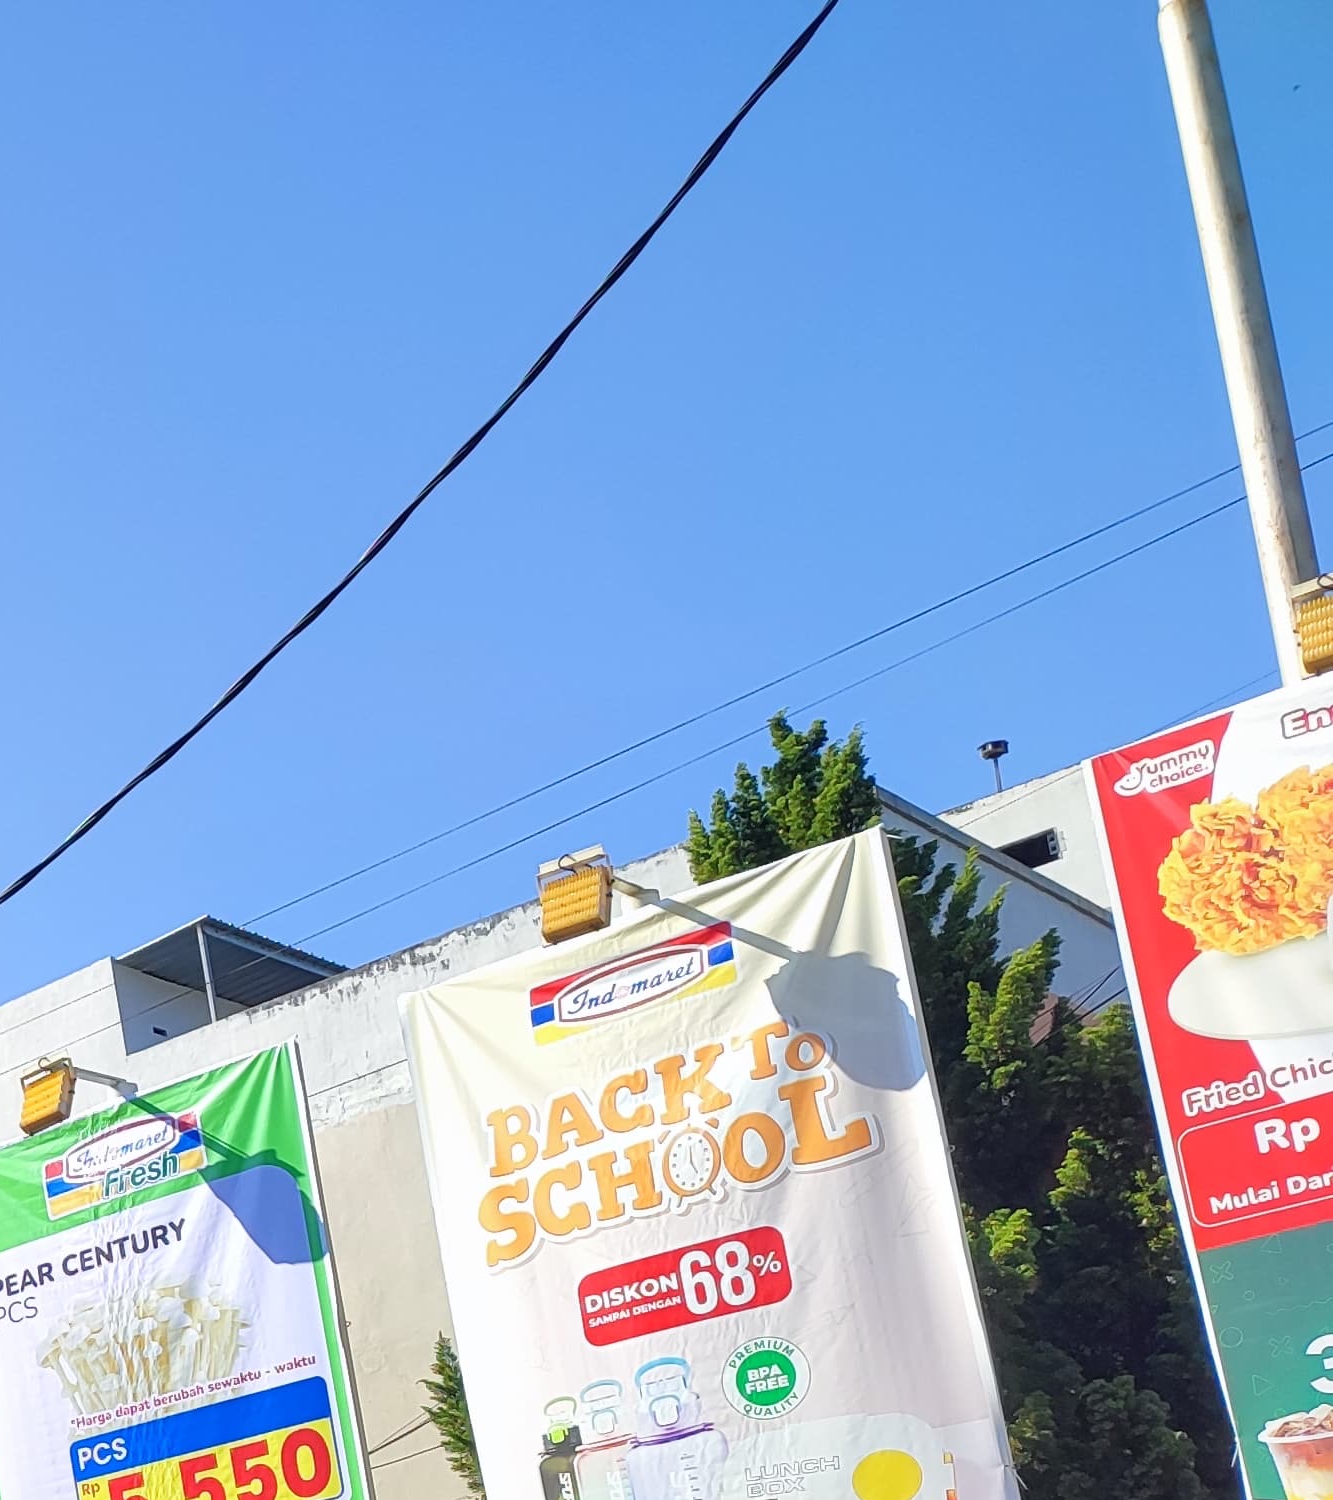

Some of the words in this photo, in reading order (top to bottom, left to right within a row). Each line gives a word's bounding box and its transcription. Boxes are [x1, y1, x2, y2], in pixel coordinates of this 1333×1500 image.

[1120, 745, 1210, 790] Yummy
[567, 957, 695, 1015] Indomaret
[1185, 1073, 1262, 1114] Fried
[1270, 1057, 1333, 1088] Chic
[486, 1043, 732, 1178] BACK
[1254, 1117, 1321, 1154] Rp
[103, 1151, 179, 1198] Fresh
[1209, 1181, 1281, 1214] Mulai
[1286, 1170, 1333, 1195] Dar
[61, 1217, 186, 1277] CENTURY
[584, 1275, 680, 1314] DISKON
[678, 1241, 782, 1317] 68%
[588, 1307, 631, 1328] SAMPAI
[633, 1296, 682, 1316] DENGAN
[728, 1340, 796, 1369] PREMIUM
[746, 1364, 783, 1381] BPA
[115, 1398, 151, 1421] dapat
[153, 1385, 205, 1410] berubah
[207, 1369, 261, 1394] sewaktu
[274, 1355, 316, 1376] waktu
[745, 1375, 789, 1394] FREE
[743, 1392, 799, 1416] QUALITY
[77, 1436, 128, 1471] PCS
[744, 1456, 841, 1482] LUNCH
[81, 1482, 101, 1500] Rp
[746, 1477, 806, 1498] BOX
